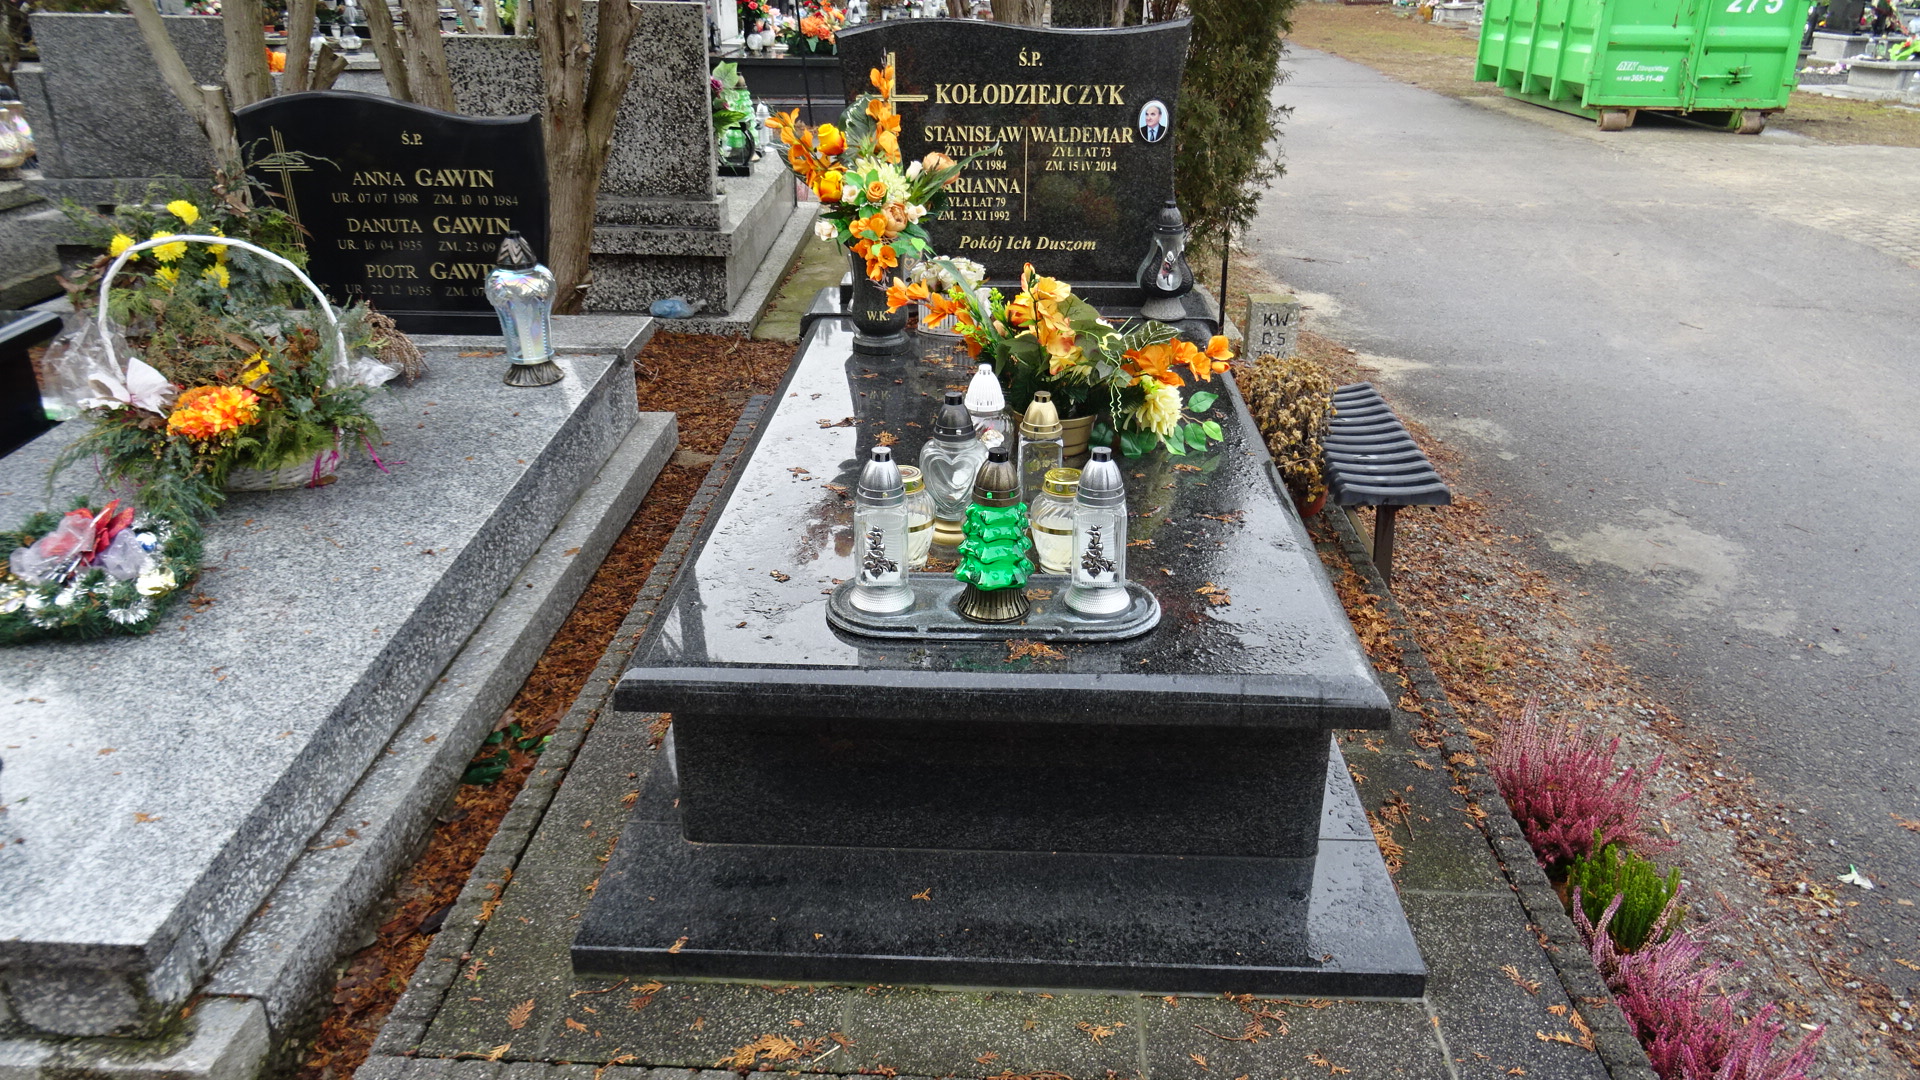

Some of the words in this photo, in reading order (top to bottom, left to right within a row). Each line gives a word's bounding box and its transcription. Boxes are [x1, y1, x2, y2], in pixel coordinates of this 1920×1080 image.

[1018, 47, 1043, 67] Ś.P.
[934, 83, 1126, 106] KOŁODZIEJCZYK
[401, 130, 423, 145] Ś.P.
[924, 125, 1024, 143] STANISŁAW
[1030, 126, 1134, 144] WALDEMAR
[944, 142, 967, 156] ŻYŁ
[1051, 143, 1074, 157] ŻYŁ
[1077, 146, 1099, 157] LAT
[1100, 146, 1112, 158] 73
[986, 160, 1007, 171] 1984
[1045, 160, 1065, 171] ZM.
[1068, 161, 1079, 171] 15
[1081, 161, 1094, 171] IV
[1095, 161, 1117, 172] 2014
[352, 171, 406, 187] ANNA
[414, 168, 495, 188] GAWIN
[943, 177, 1021, 194] ARIANNA
[331, 192, 354, 204] UR.
[358, 193, 371, 204] 07
[374, 193, 388, 204] 07
[393, 193, 419, 204] 1908
[433, 193, 457, 205] ZM.
[461, 194, 472, 205] 10
[477, 195, 489, 206] 10
[493, 195, 519, 206] 1984
[946, 196, 970, 208] YŁA
[972, 196, 993, 208] LAT
[995, 197, 1006, 208] 79
[937, 210, 957, 221] ZM.
[961, 210, 973, 221] 23
[974, 210, 987, 221] XI
[989, 210, 1010, 221] 1992
[346, 218, 424, 234] DANUTA
[432, 215, 511, 235] GAWIN
[337, 239, 360, 250] UR.
[364, 240, 376, 250] 16
[380, 240, 394, 250] 04
[398, 240, 423, 251] 1935
[438, 241, 462, 252] ZM.
[465, 241, 479, 252] 23
[482, 242, 496, 253] 09
[958, 235, 1003, 253] Pokój
[1006, 236, 1031, 250] Ich
[1035, 236, 1097, 251] Duszom
[364, 264, 419, 279] PIOTR
[430, 261, 496, 280] GAWI
[407, 285, 433, 296] 1935
[866, 310, 890, 321] W.K.
[1263, 313, 1289, 326] KW
